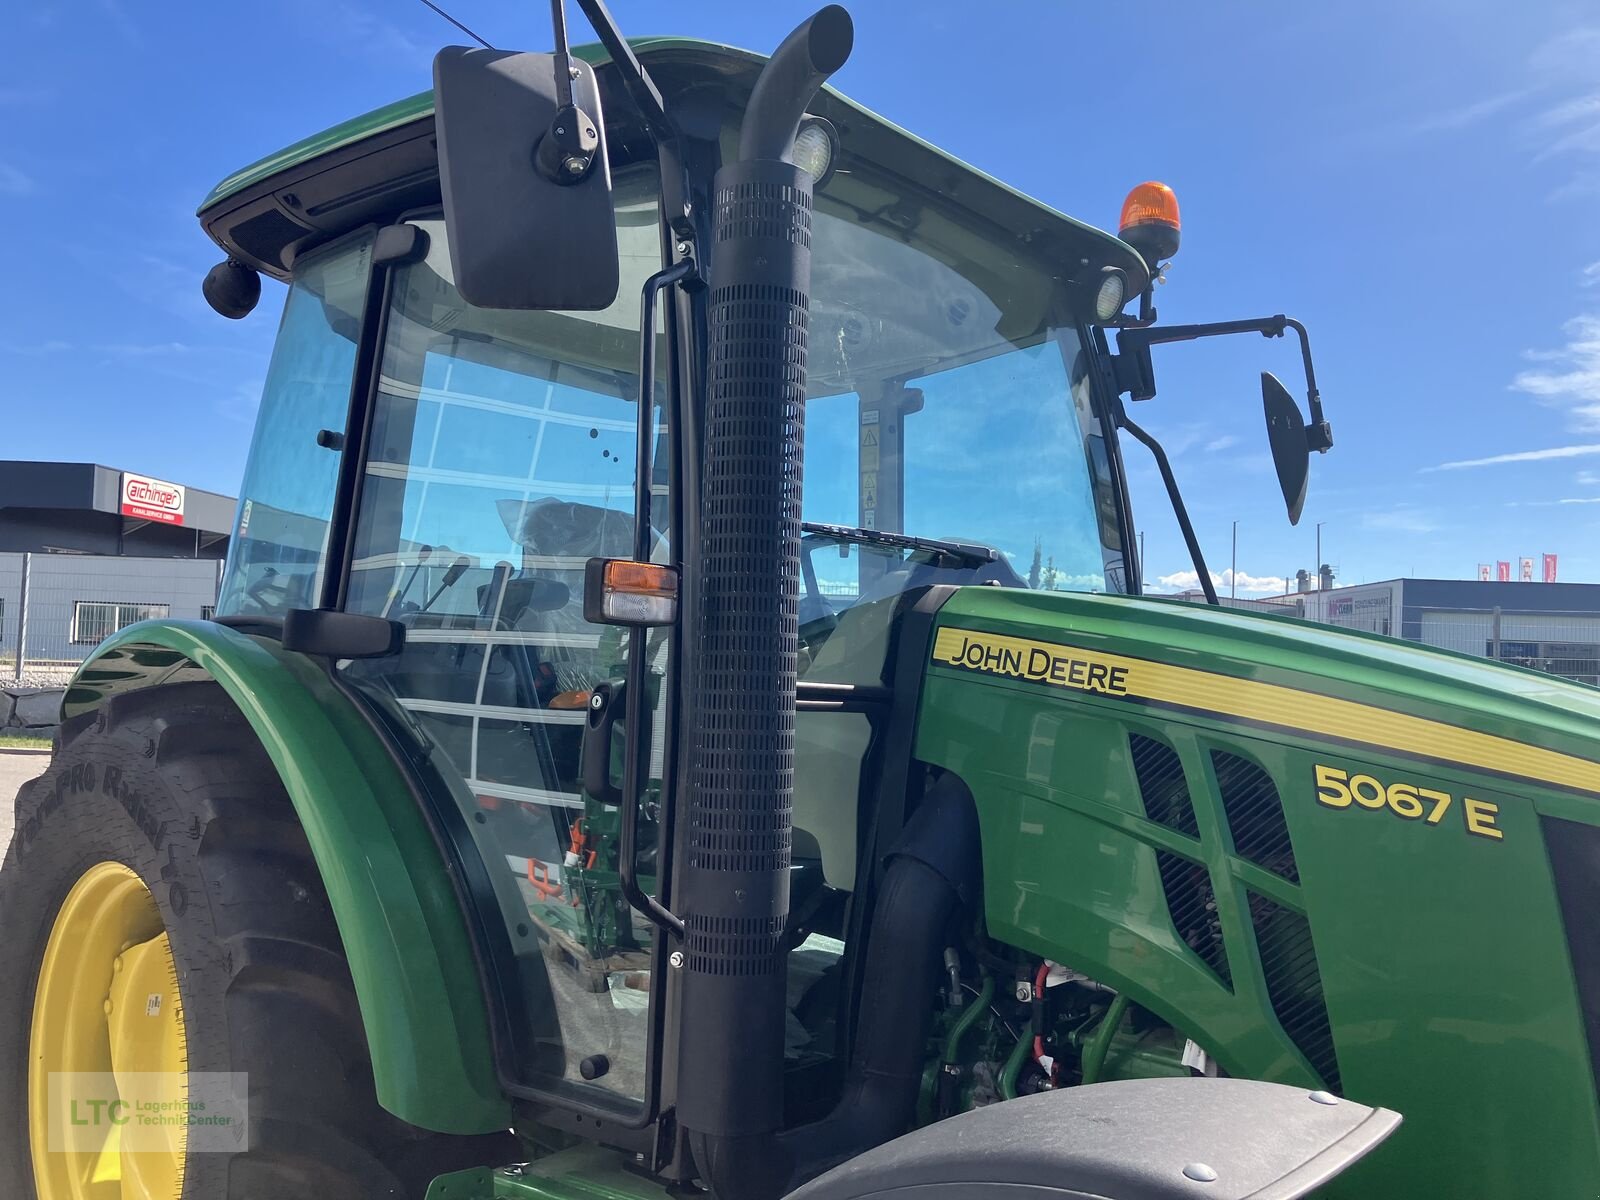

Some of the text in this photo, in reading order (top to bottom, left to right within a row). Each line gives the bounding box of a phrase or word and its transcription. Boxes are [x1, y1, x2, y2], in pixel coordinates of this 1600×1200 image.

[130, 484, 178, 507] aichinger
[951, 637, 1129, 692] JOHN DEERE
[1314, 763, 1504, 839] 5067 E
